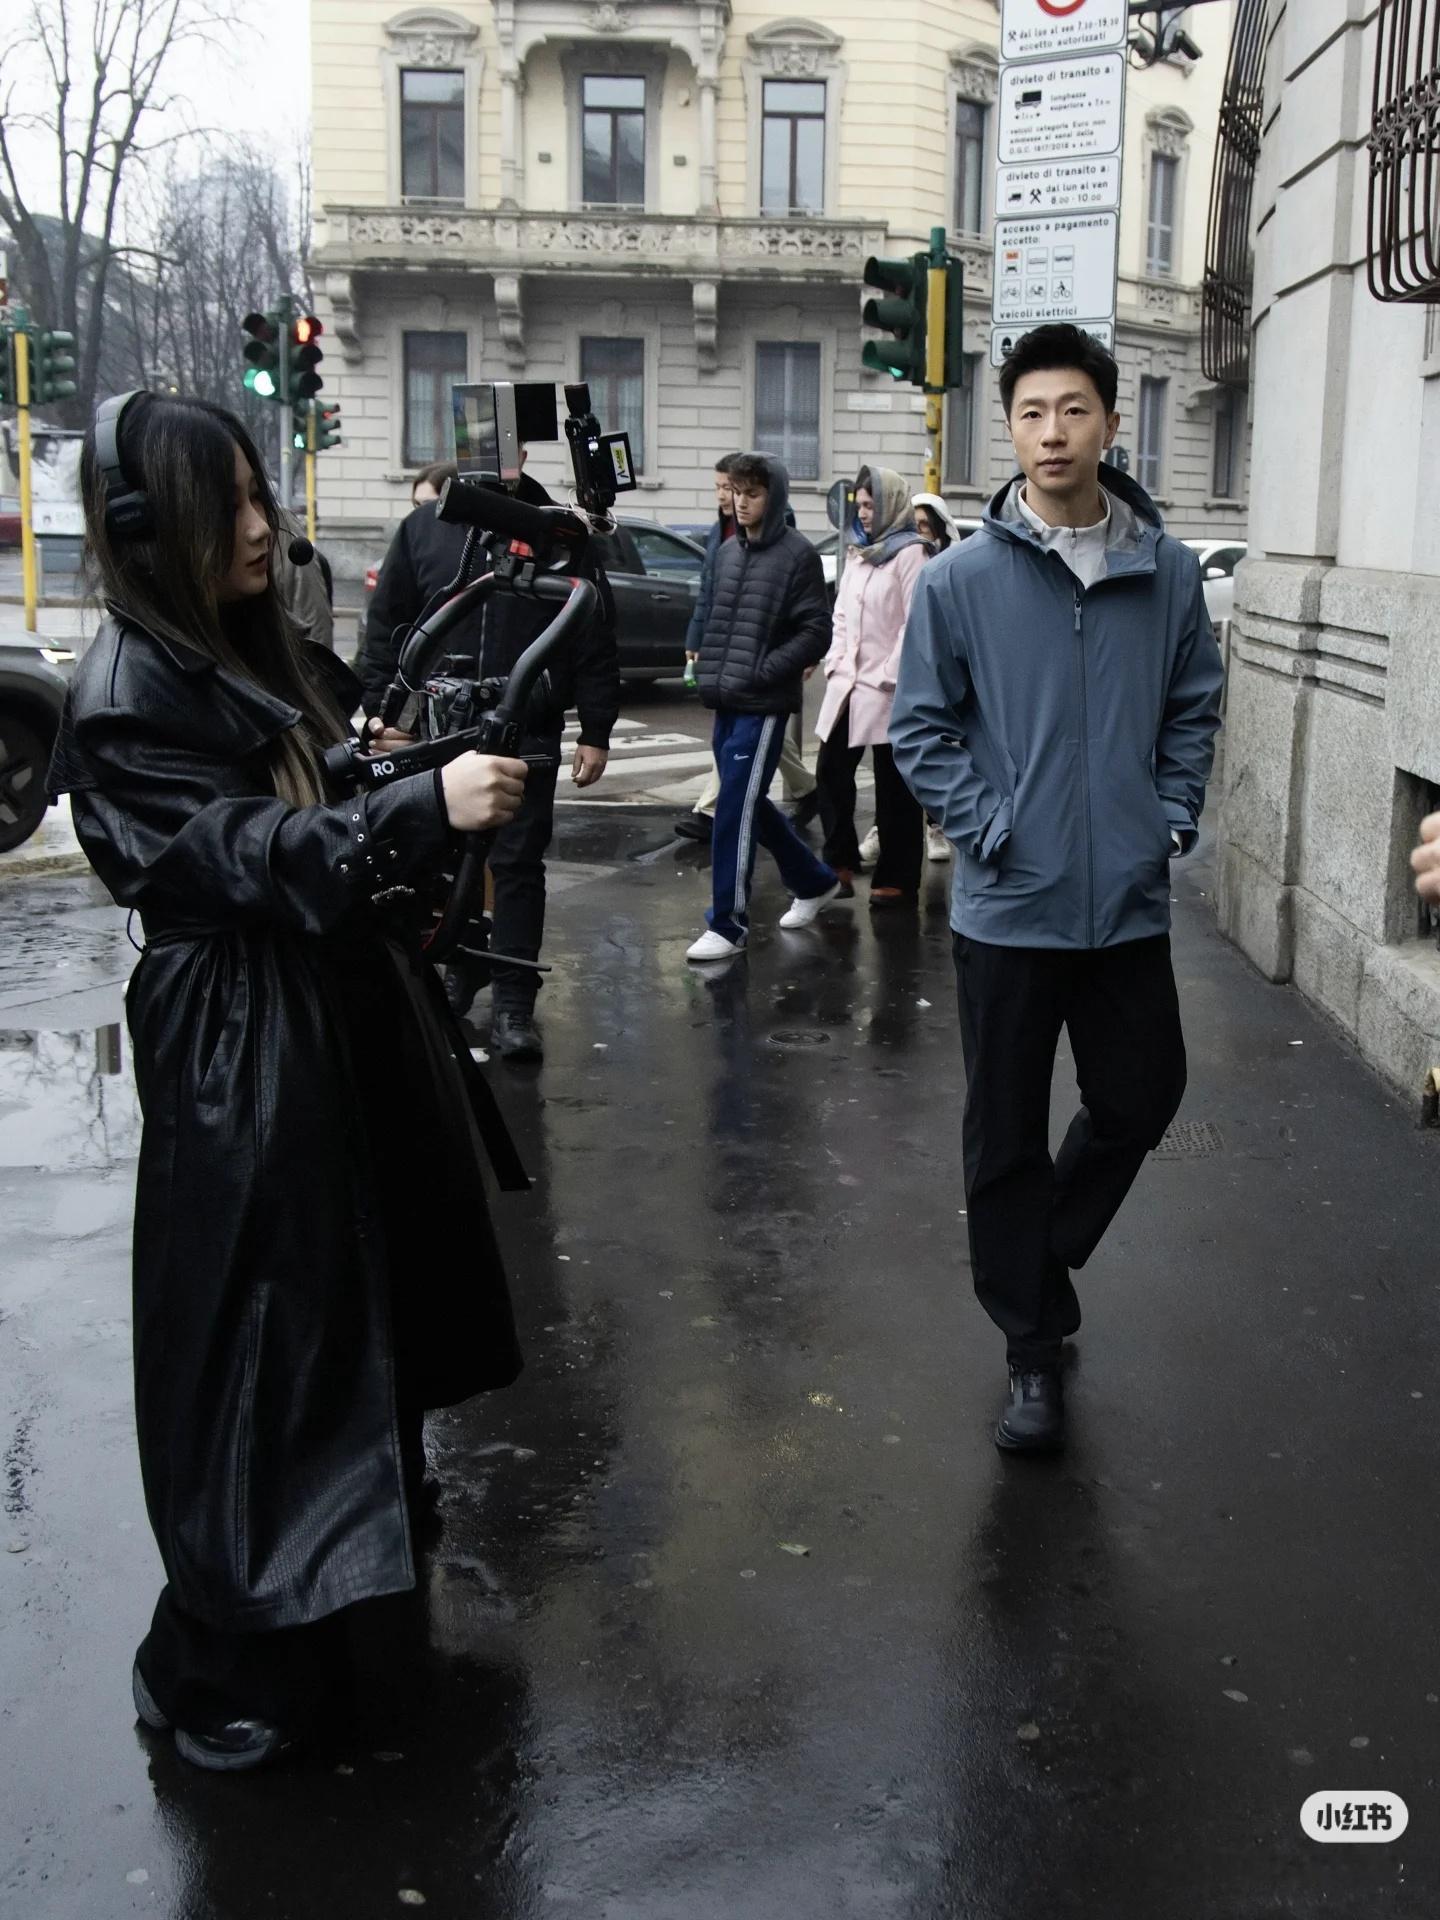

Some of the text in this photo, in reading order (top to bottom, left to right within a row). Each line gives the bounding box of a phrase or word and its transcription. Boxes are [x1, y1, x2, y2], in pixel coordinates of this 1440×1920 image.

[1020, 32, 1106, 51] eccetto autorizzati
[1010, 74, 1043, 85] divieto
[1047, 71, 1056, 81] di
[1060, 67, 1101, 80] transito
[1050, 101, 1084, 111] superiore
[1006, 171, 1039, 182] divieto
[1043, 168, 1052, 178] di
[1056, 165, 1096, 177] transito
[1046, 181, 1108, 193] dal lun al ven
[1003, 223, 1041, 234] accesso
[1054, 218, 1109, 231] pagamento
[1000, 306, 1077, 319] veicoli elettrici
